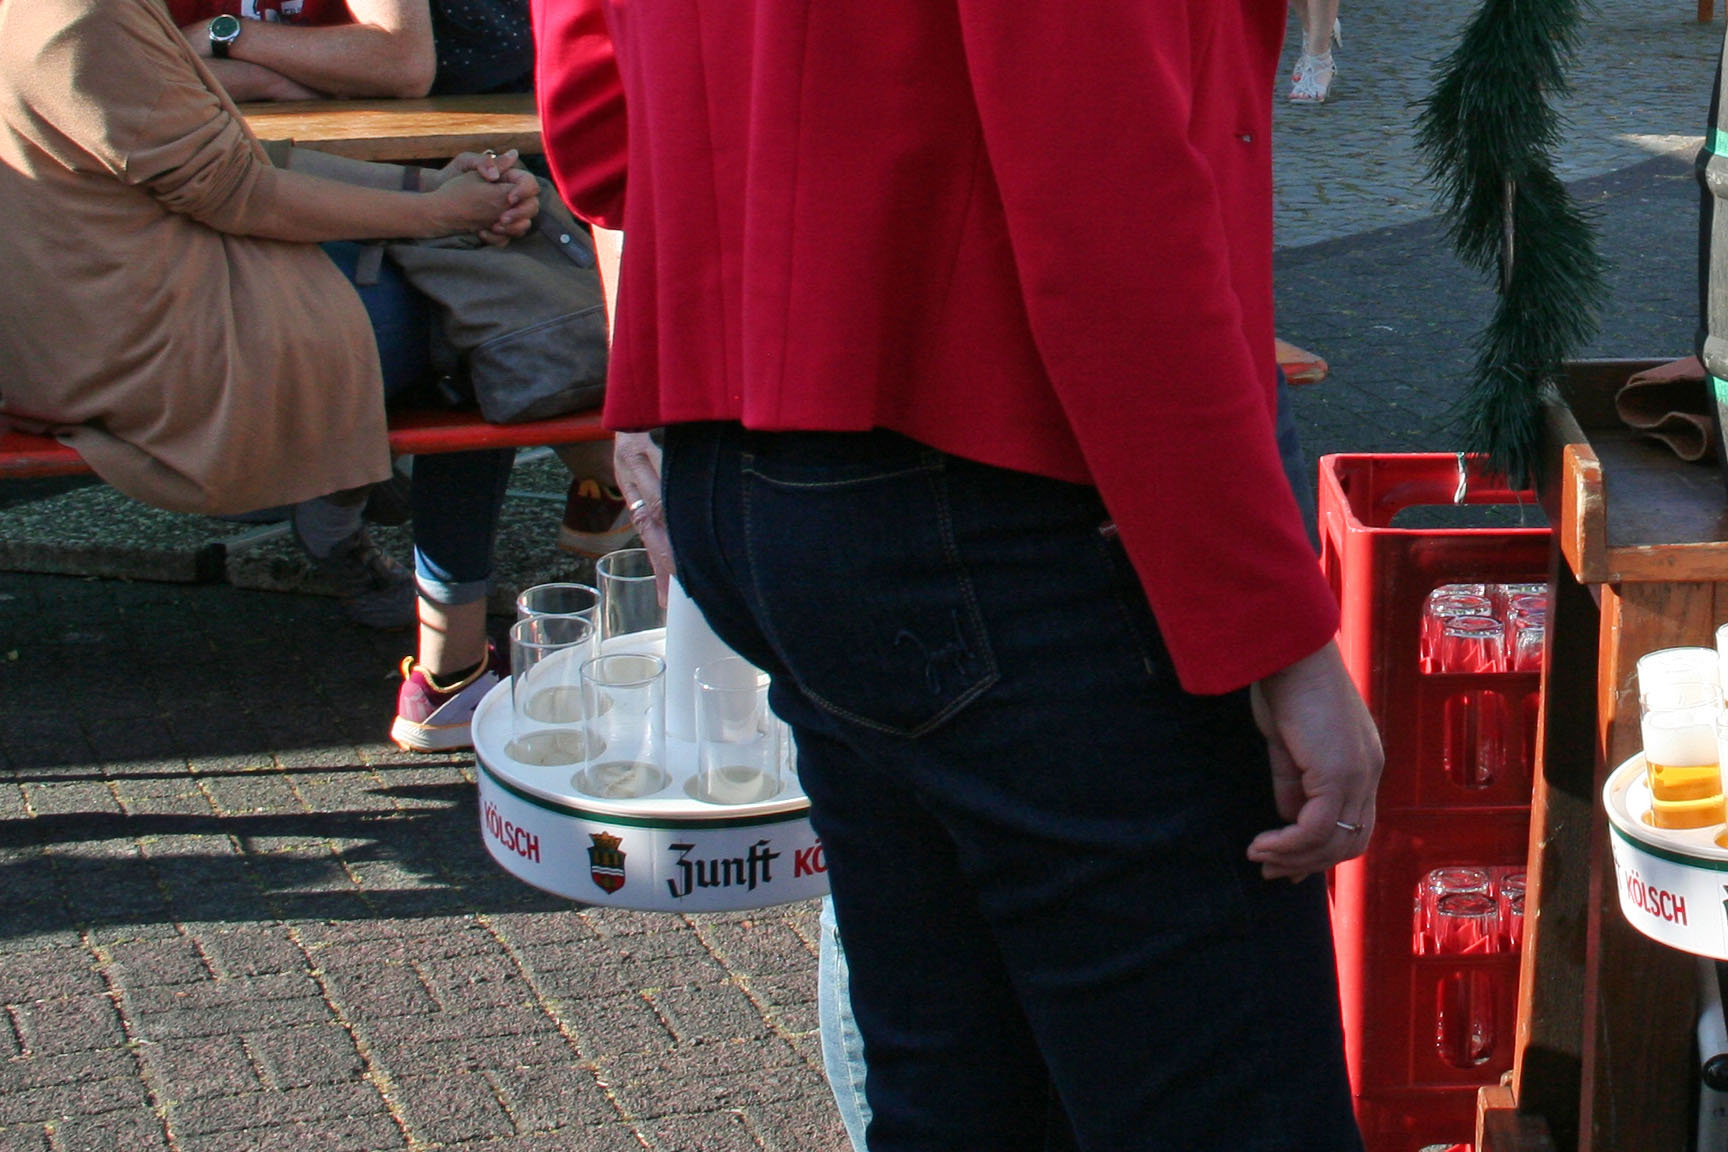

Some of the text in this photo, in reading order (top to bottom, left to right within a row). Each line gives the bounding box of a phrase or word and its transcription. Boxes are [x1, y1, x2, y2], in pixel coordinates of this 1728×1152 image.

[485, 800, 541, 864] KÖLSCH
[667, 839, 782, 900] Zunft
[1625, 869, 1688, 926] KÖLSCH
